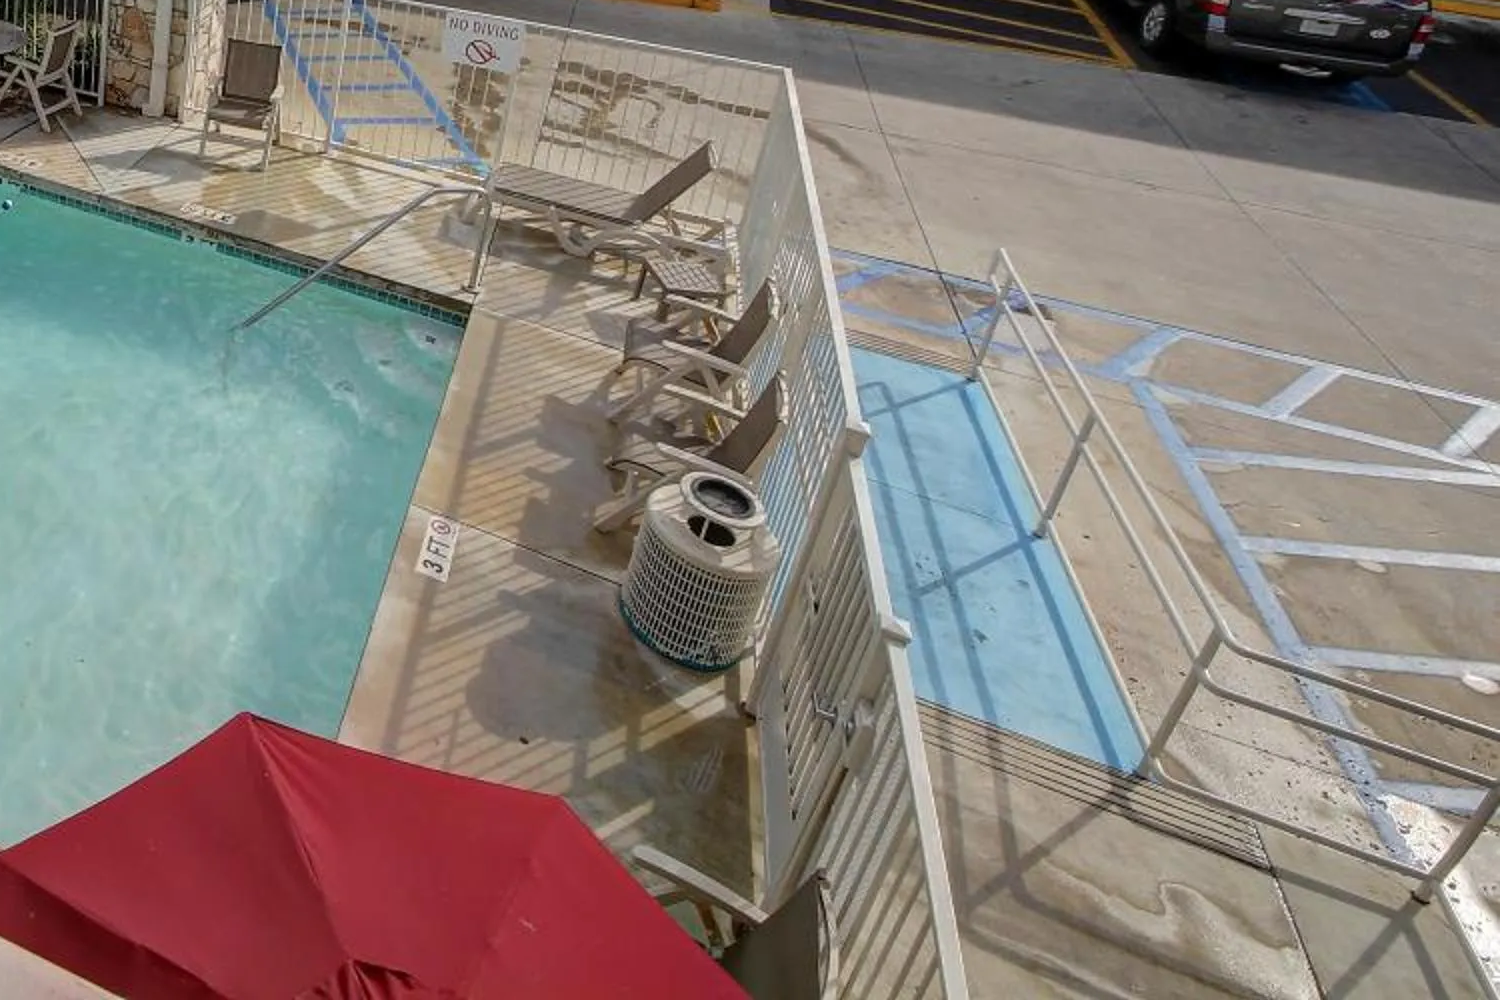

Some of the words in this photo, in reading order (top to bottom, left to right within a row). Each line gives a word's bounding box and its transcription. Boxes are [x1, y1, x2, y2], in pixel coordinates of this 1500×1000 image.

[449, 17, 468, 32] NO
[473, 20, 519, 40] DIVING
[427, 536, 450, 559] FT
[423, 559, 443, 573] 3
